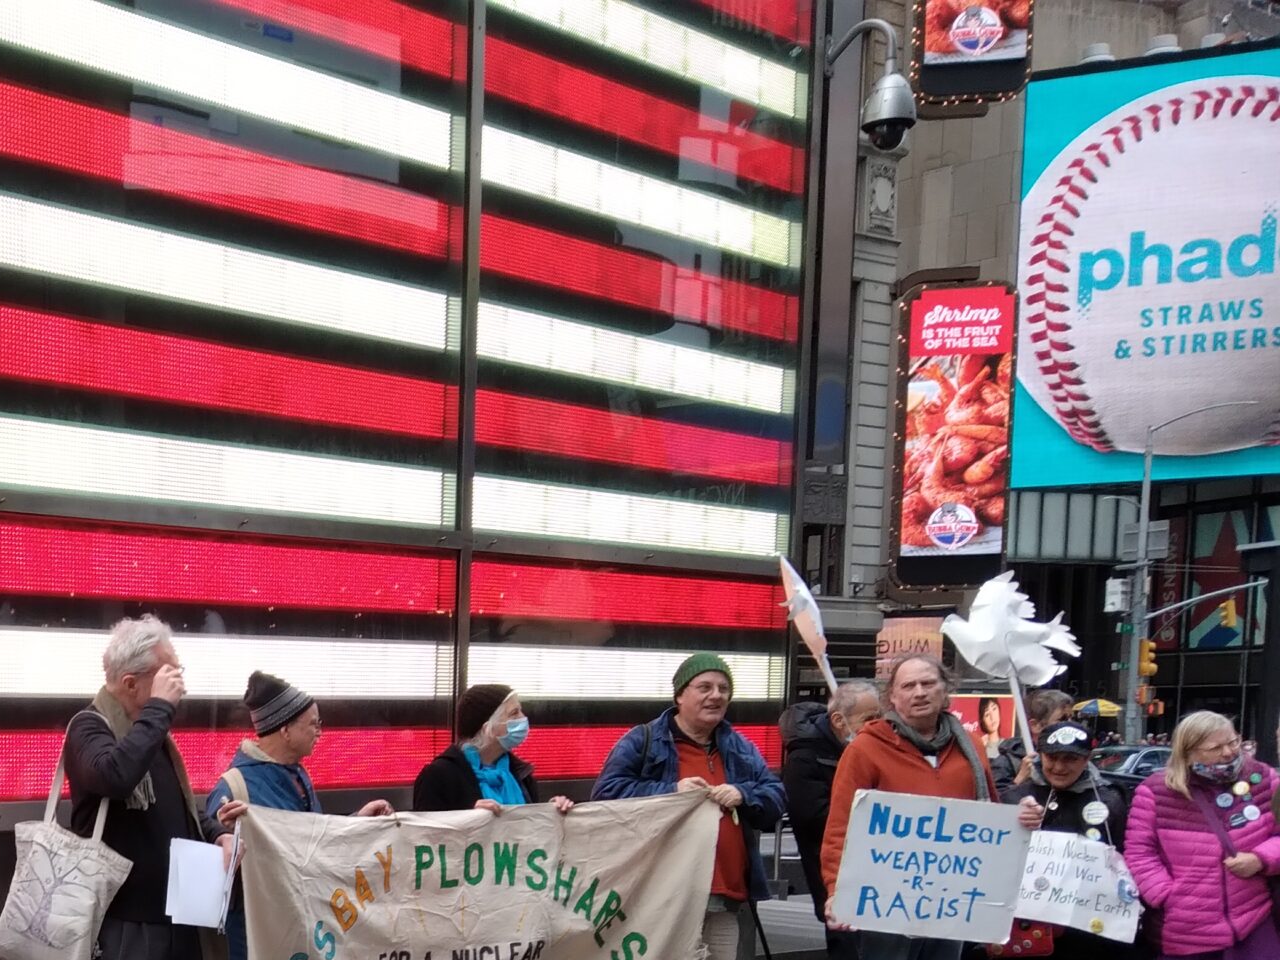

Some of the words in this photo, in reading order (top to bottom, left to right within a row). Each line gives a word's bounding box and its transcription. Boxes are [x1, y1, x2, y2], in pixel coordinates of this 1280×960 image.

[1077, 204, 1280, 316] phad
[923, 304, 1002, 327] Shrimp
[1140, 298, 1264, 329] STRAWS
[921, 329, 935, 339] IS
[936, 327, 962, 338] THE
[964, 325, 1002, 337] FRUIT
[924, 339, 942, 350] OF
[944, 337, 970, 349] THE
[972, 335, 999, 347] SEA
[1114, 339, 1132, 360] &
[1142, 326, 1280, 358] STIRRERS
[877, 638, 930, 654] DIUM
[1028, 834, 1055, 857] olish
[870, 848, 983, 878] WEAPONS
[1043, 860, 1066, 877] All
[1075, 865, 1103, 882] War
[329, 844, 394, 933] BAY
[1019, 884, 1042, 900] ture
[1048, 886, 1090, 907] Mother
[1094, 893, 1132, 919] Earth
